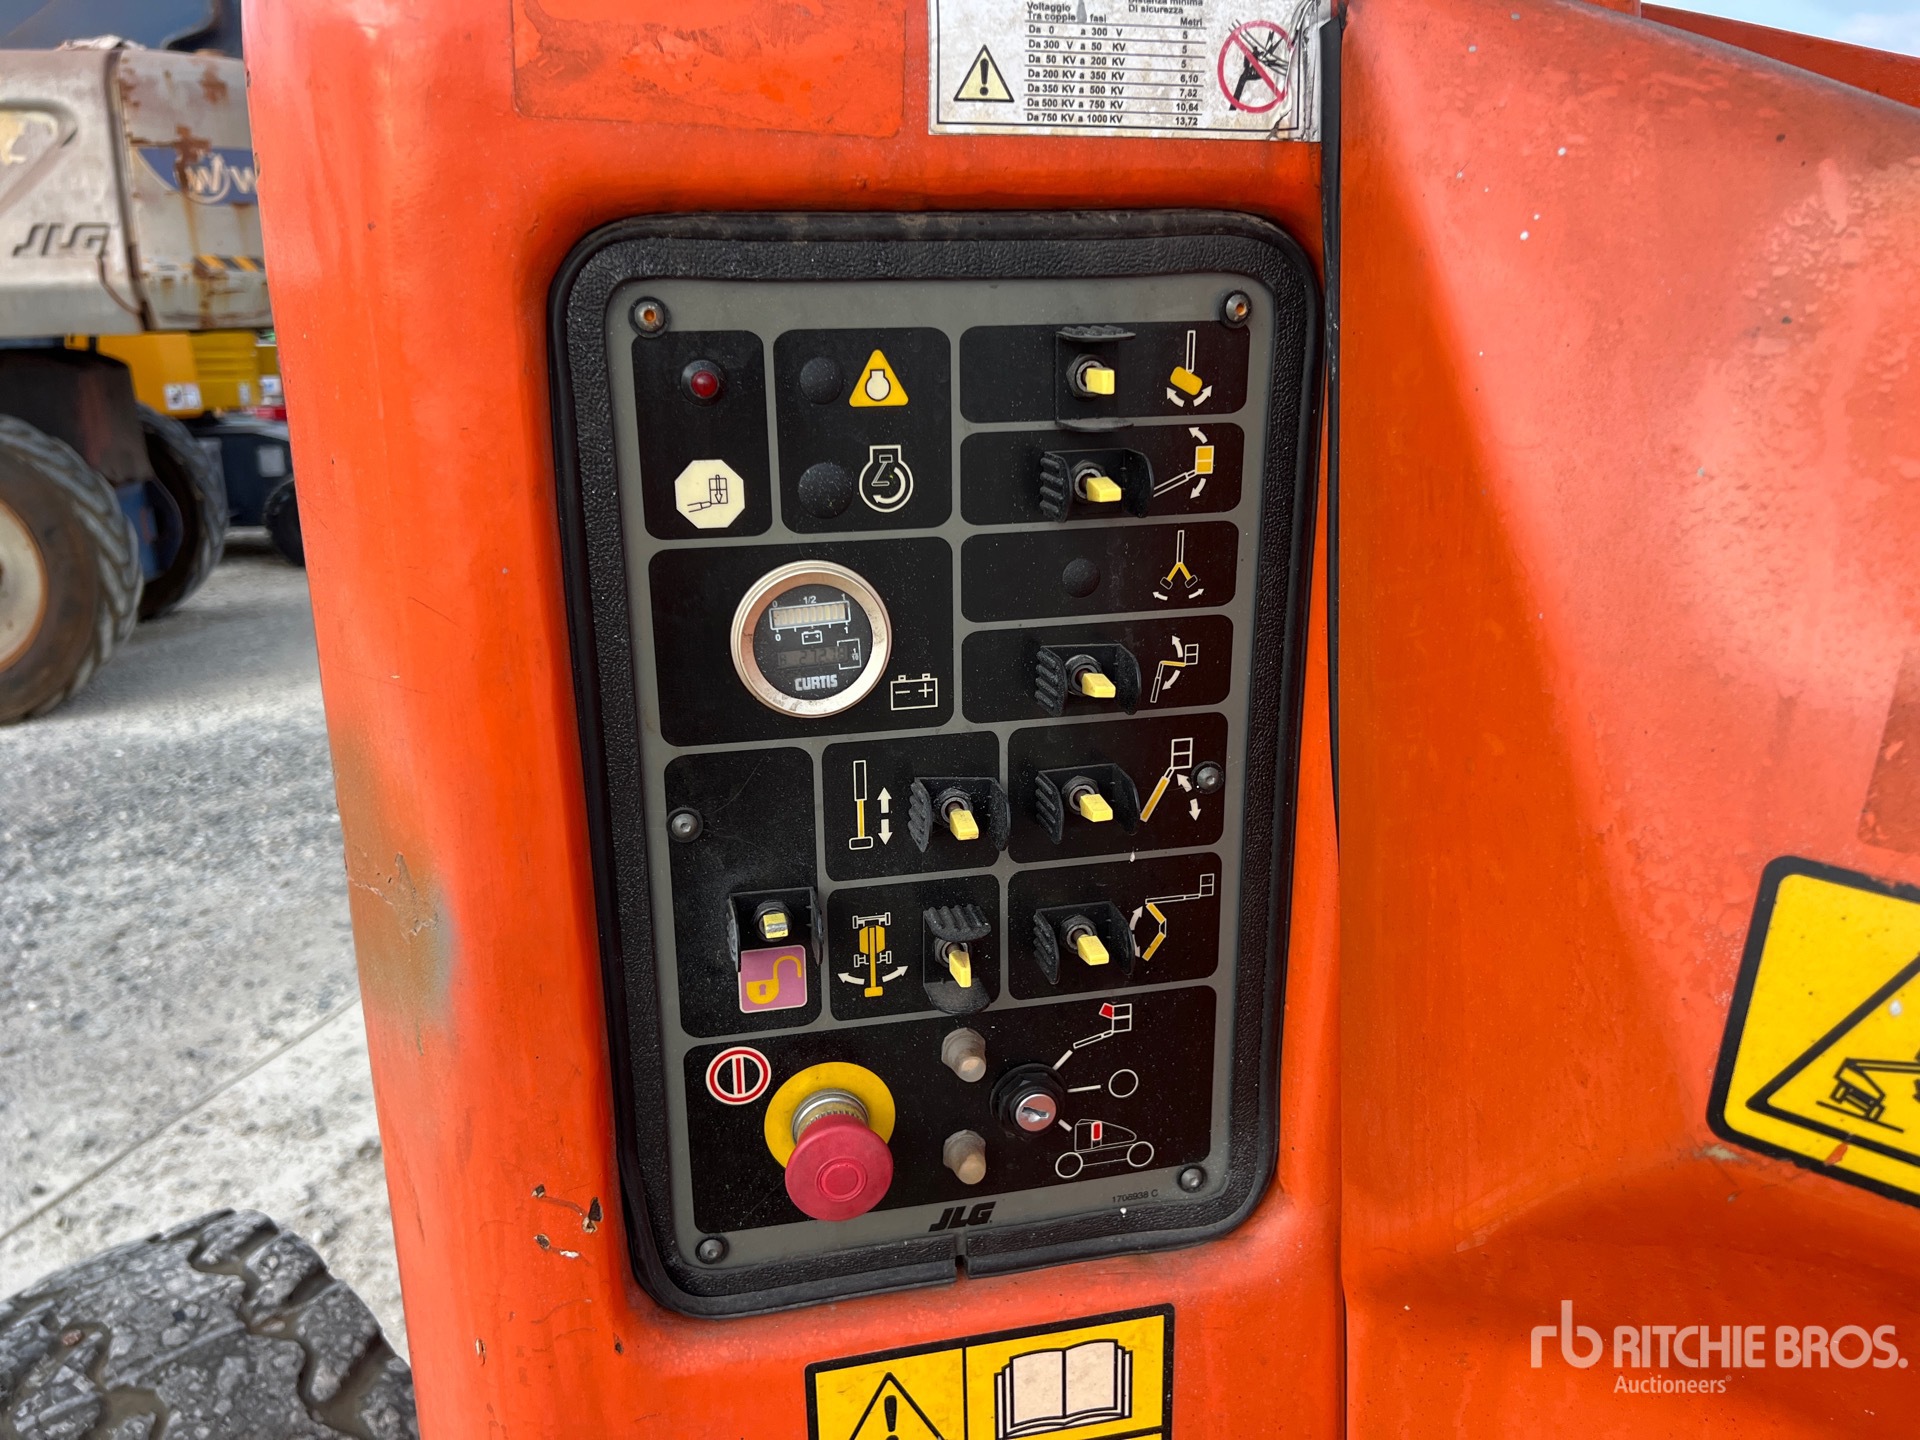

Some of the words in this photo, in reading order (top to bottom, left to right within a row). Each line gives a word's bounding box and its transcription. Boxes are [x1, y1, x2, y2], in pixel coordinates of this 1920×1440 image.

[1027, 2, 1071, 12] Voltaggio
[1128, 4, 1138, 12] Di
[1141, 5, 1184, 14] sicurezza
[1027, 11, 1042, 20] Tra
[1044, 13, 1076, 23] coppie
[1090, 14, 1106, 23] fasi
[1180, 17, 1202, 26] Metri
[1028, 25, 1041, 34] Da
[1049, 26, 1054, 34] 0
[1092, 27, 1108, 36] 300
[1116, 28, 1123, 37] V
[1183, 31, 1188, 39] 5
[1028, 40, 1041, 49] Da
[1044, 40, 1060, 49] 300
[1067, 41, 1073, 50] V
[1091, 42, 1102, 50] 50
[1112, 43, 1126, 51] KV
[1182, 45, 1187, 54] 5
[1028, 54, 1041, 63] Da
[1046, 55, 1056, 64] 50
[1063, 56, 1076, 64] KV
[1091, 57, 1106, 65] 200
[1112, 57, 1125, 66] KV
[1181, 60, 1186, 68] 5
[1028, 69, 1040, 78] Da
[1043, 69, 1059, 78] 200
[1062, 70, 1076, 79] KV
[1090, 71, 1106, 80] 350
[1111, 72, 1125, 80] KV
[1028, 84, 1040, 92] Da
[1042, 84, 1058, 93] 350
[1062, 85, 1075, 94] KV
[1090, 86, 1105, 94] 500
[1111, 86, 1124, 95] KV
[1027, 98, 1039, 107] Da
[1042, 98, 1058, 107] 500
[1061, 99, 1075, 108] KV
[1090, 100, 1105, 109] 750
[1110, 101, 1124, 110] KV
[1176, 103, 1198, 113] 10,64
[1027, 113, 1039, 121] Da
[1042, 113, 1057, 122] 750
[1061, 114, 1074, 122] KV
[1087, 114, 1107, 123] 1000
[1110, 115, 1123, 123] KV
[1175, 117, 1198, 126] 13,72
[12, 223, 110, 257] JLG
[803, 596, 817, 604] 1/2
[794, 674, 838, 691] CURTIS
[1151, 1189, 1158, 1197] C
[928, 1201, 996, 1232] JLG
